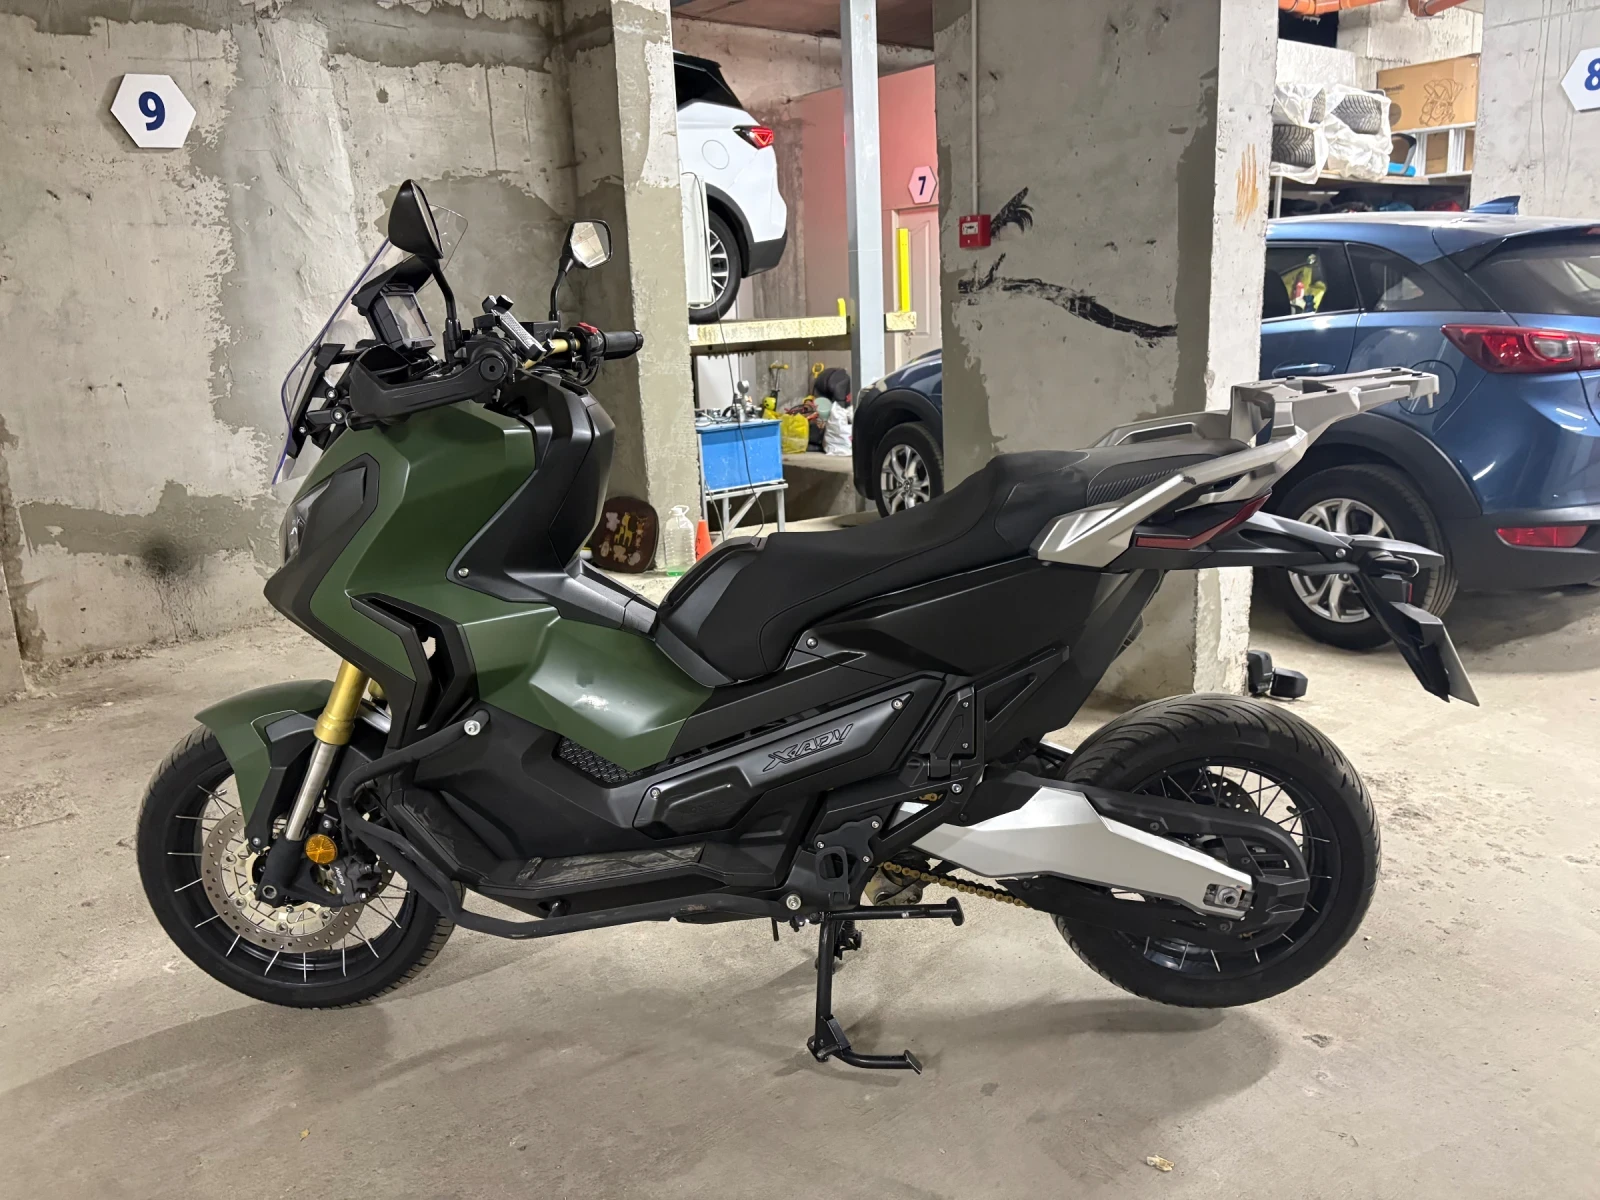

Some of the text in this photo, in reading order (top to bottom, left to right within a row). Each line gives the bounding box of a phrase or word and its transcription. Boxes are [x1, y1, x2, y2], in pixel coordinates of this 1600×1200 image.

[1584, 57, 1600, 91] 8
[138, 91, 166, 131] 9
[918, 175, 927, 196] 7
